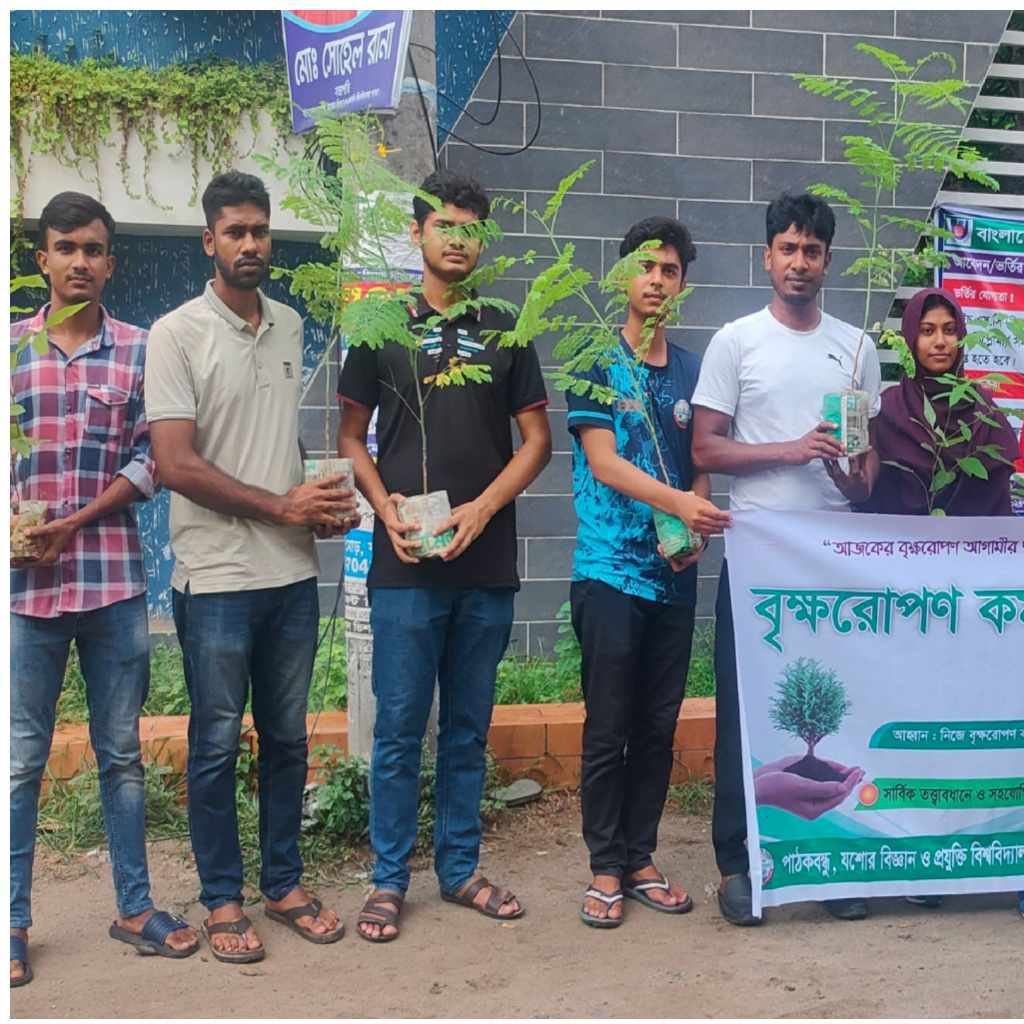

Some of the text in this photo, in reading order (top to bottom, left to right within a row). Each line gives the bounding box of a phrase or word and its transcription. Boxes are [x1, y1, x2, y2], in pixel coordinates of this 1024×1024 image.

[322, 32, 365, 78] সোহেল
[367, 22, 396, 65] রানা
[898, 540, 960, 559] বৃক্ষরোপণ
[963, 537, 1016, 556] আগামীর
[749, 584, 964, 653] বৃক্ষরোপণ
[940, 727, 965, 743] নিজে
[969, 730, 1016, 745] বৃক্ষরোপণ
[883, 784, 915, 801] সার্বিক
[976, 790, 985, 801] ও
[841, 851, 876, 871] যশোর
[880, 845, 916, 870] বিজ্ঞান
[921, 852, 931, 867] ও
[934, 843, 968, 872] প্রযুক্তি
